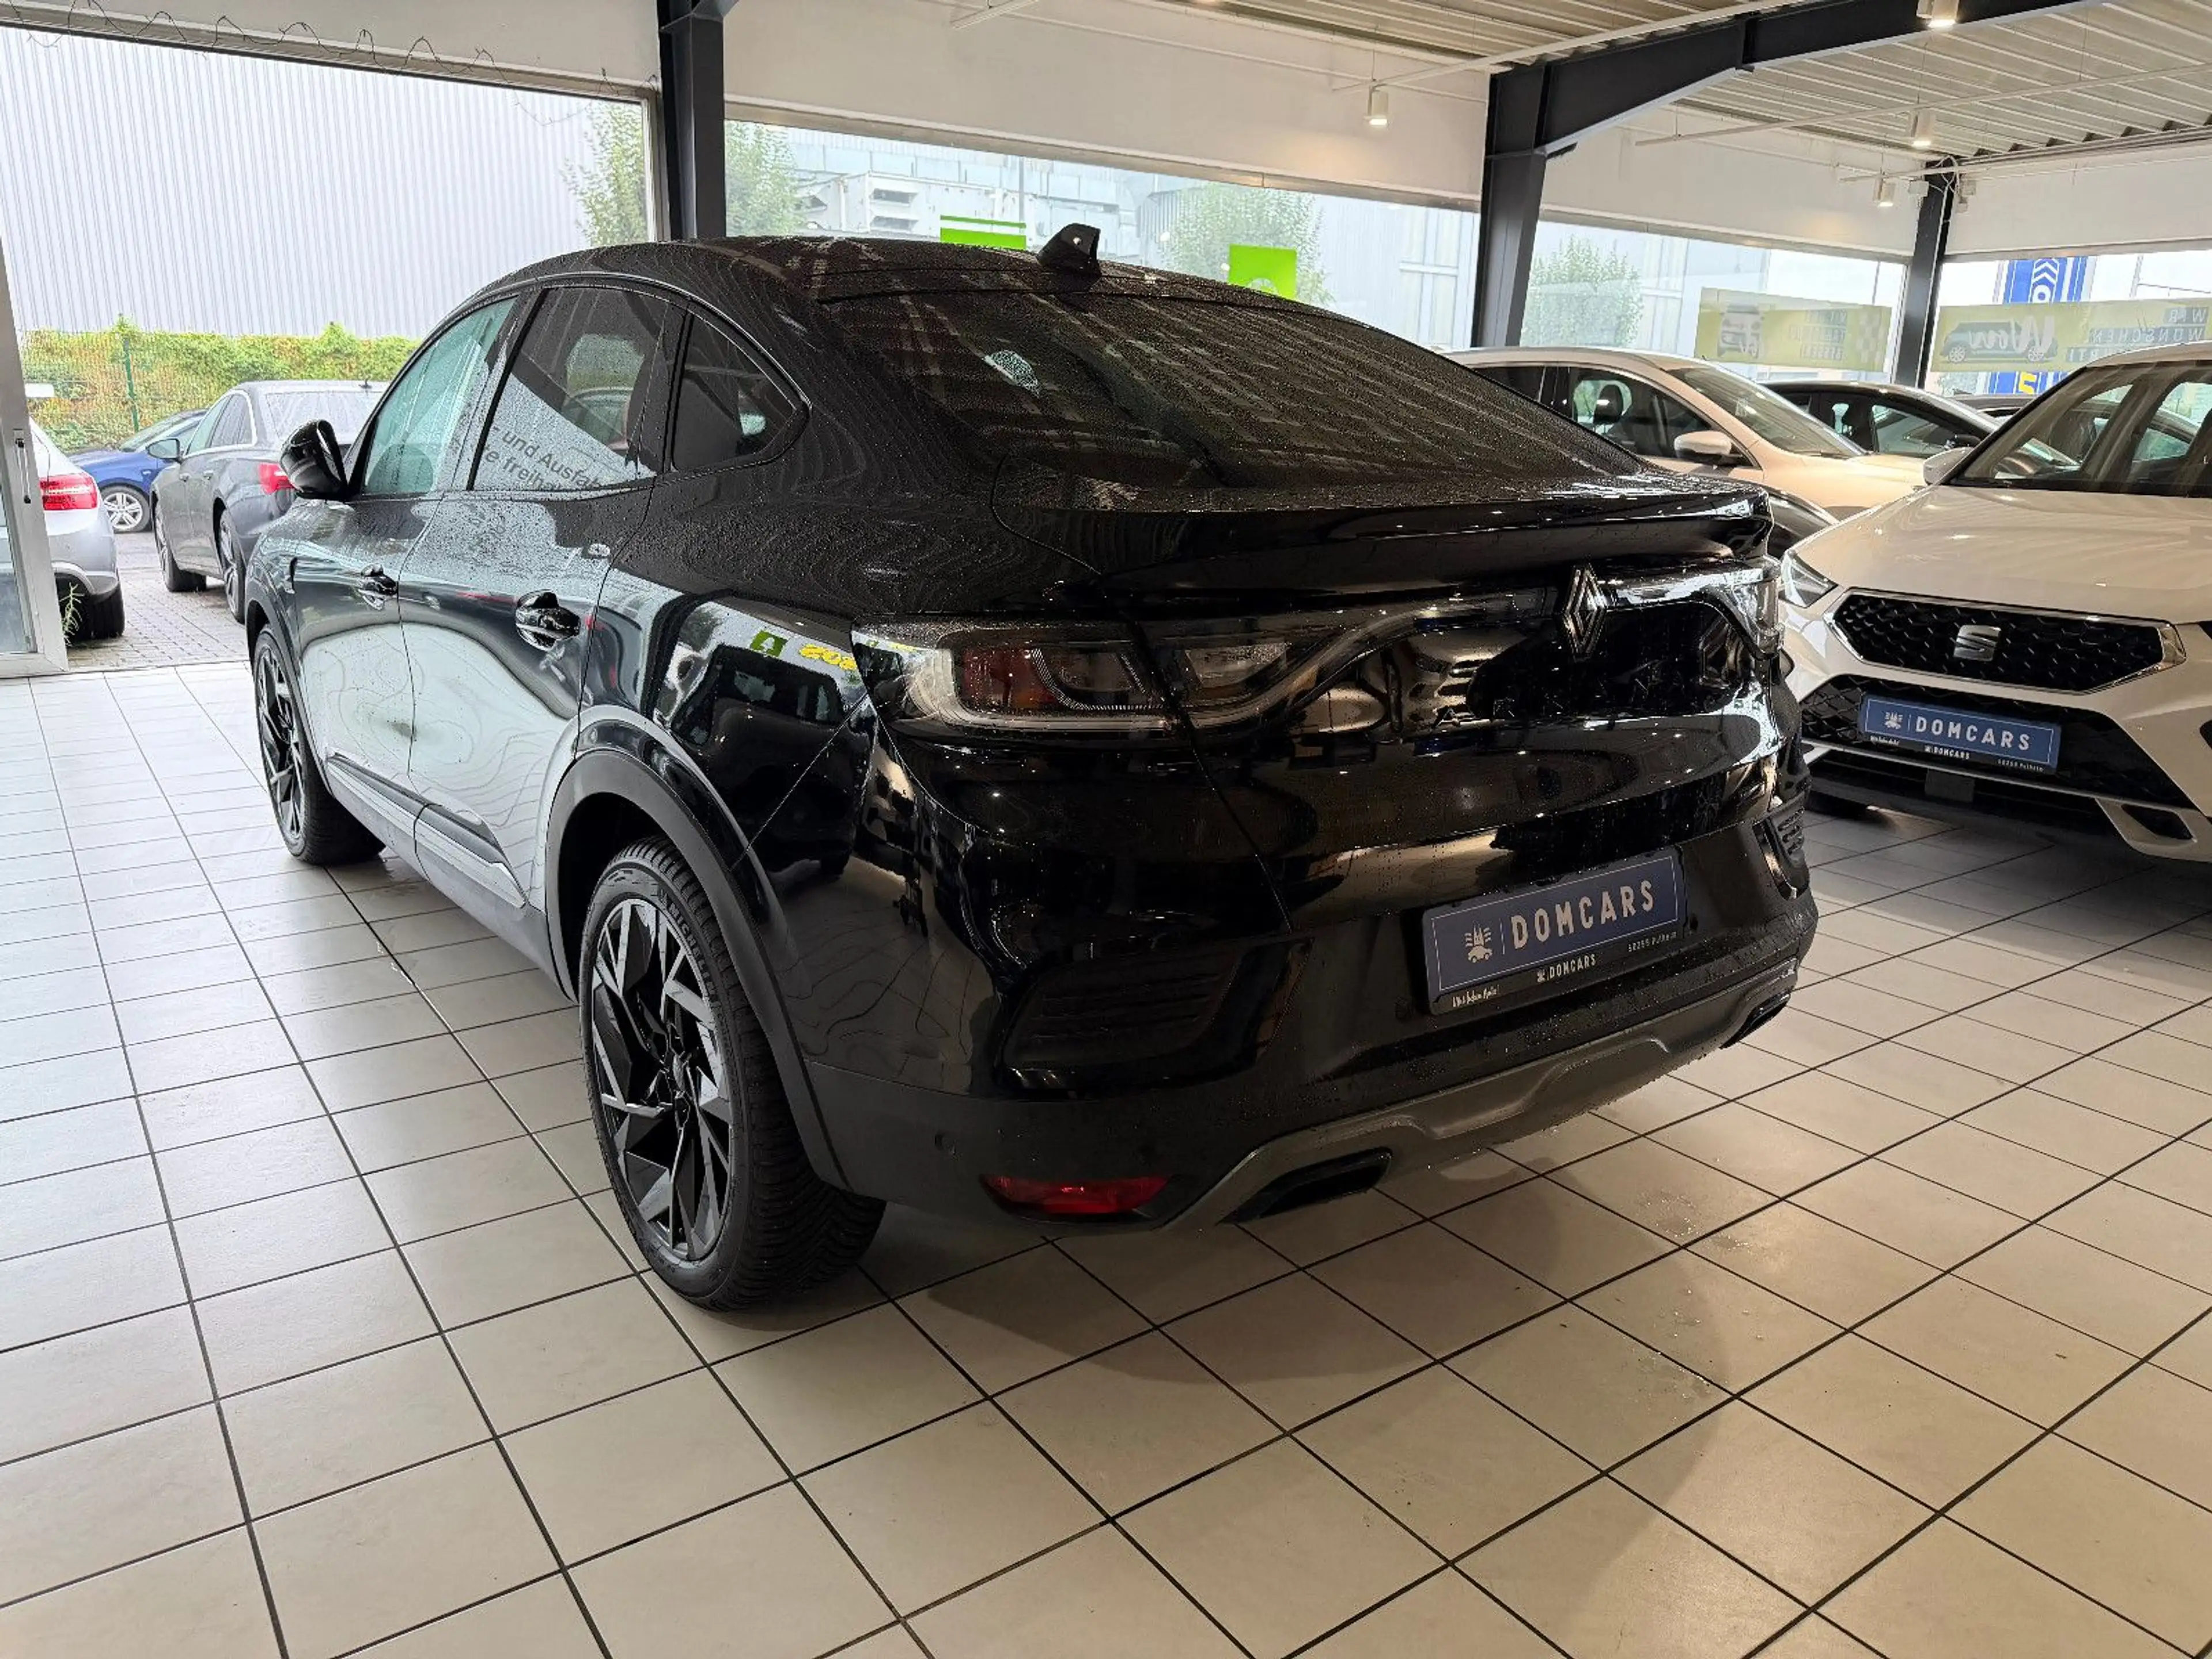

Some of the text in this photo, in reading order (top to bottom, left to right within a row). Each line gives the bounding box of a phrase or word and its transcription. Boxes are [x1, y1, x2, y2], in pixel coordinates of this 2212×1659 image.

[502, 431, 540, 458] und
[1915, 715, 2031, 751] DOMCARS
[1510, 880, 1654, 950] DOMCARS
[668, 900, 717, 995] MICHELIN
[1549, 953, 1596, 979] DOMCARS
